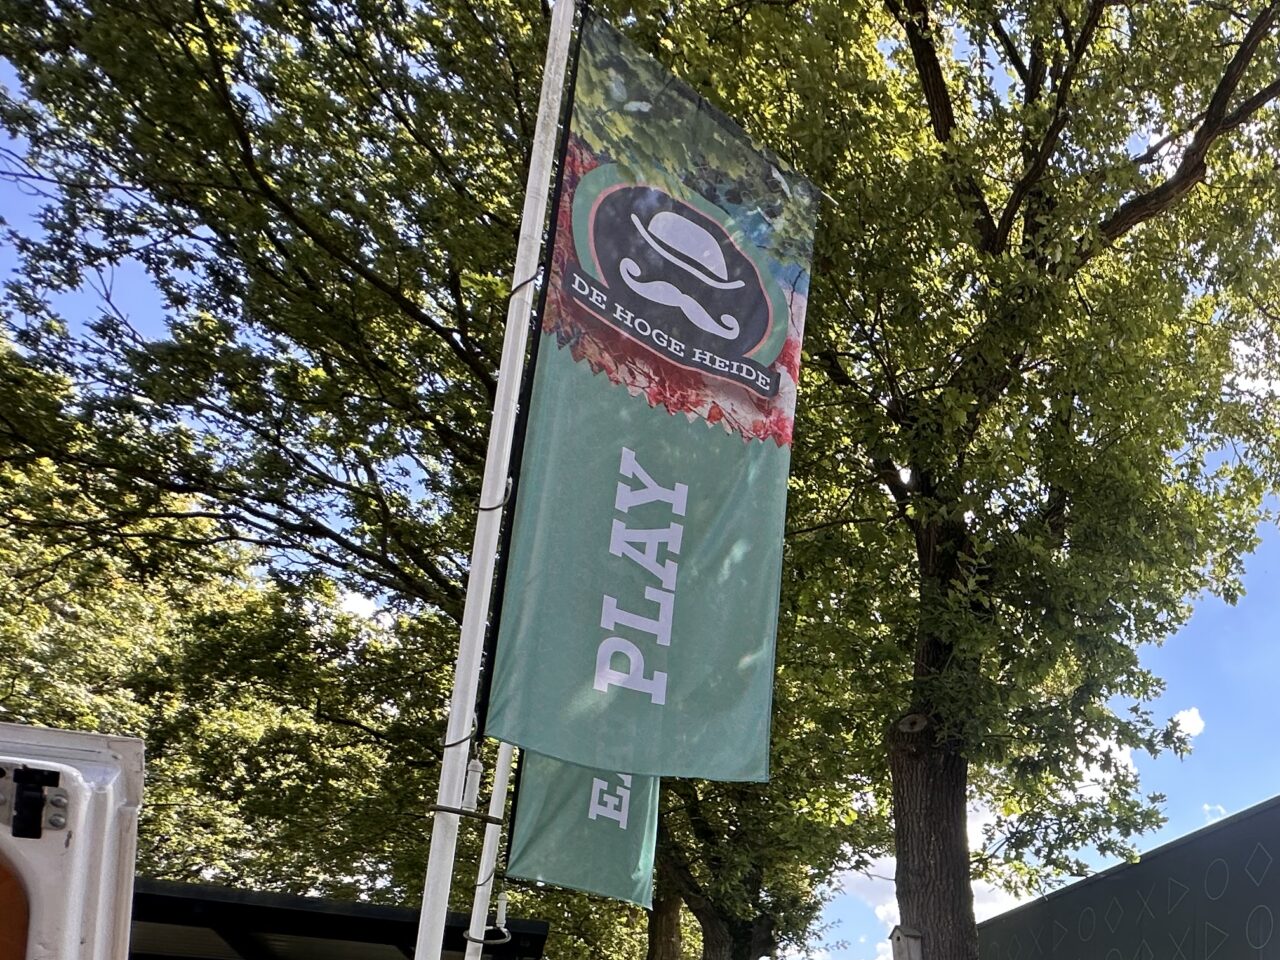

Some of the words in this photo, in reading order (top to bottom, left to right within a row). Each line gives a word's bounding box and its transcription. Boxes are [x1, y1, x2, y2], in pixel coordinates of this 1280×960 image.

[572, 273, 606, 310] DE
[614, 302, 685, 357] HOGE
[691, 348, 772, 391] HEIDE
[594, 447, 688, 705] PLAY
